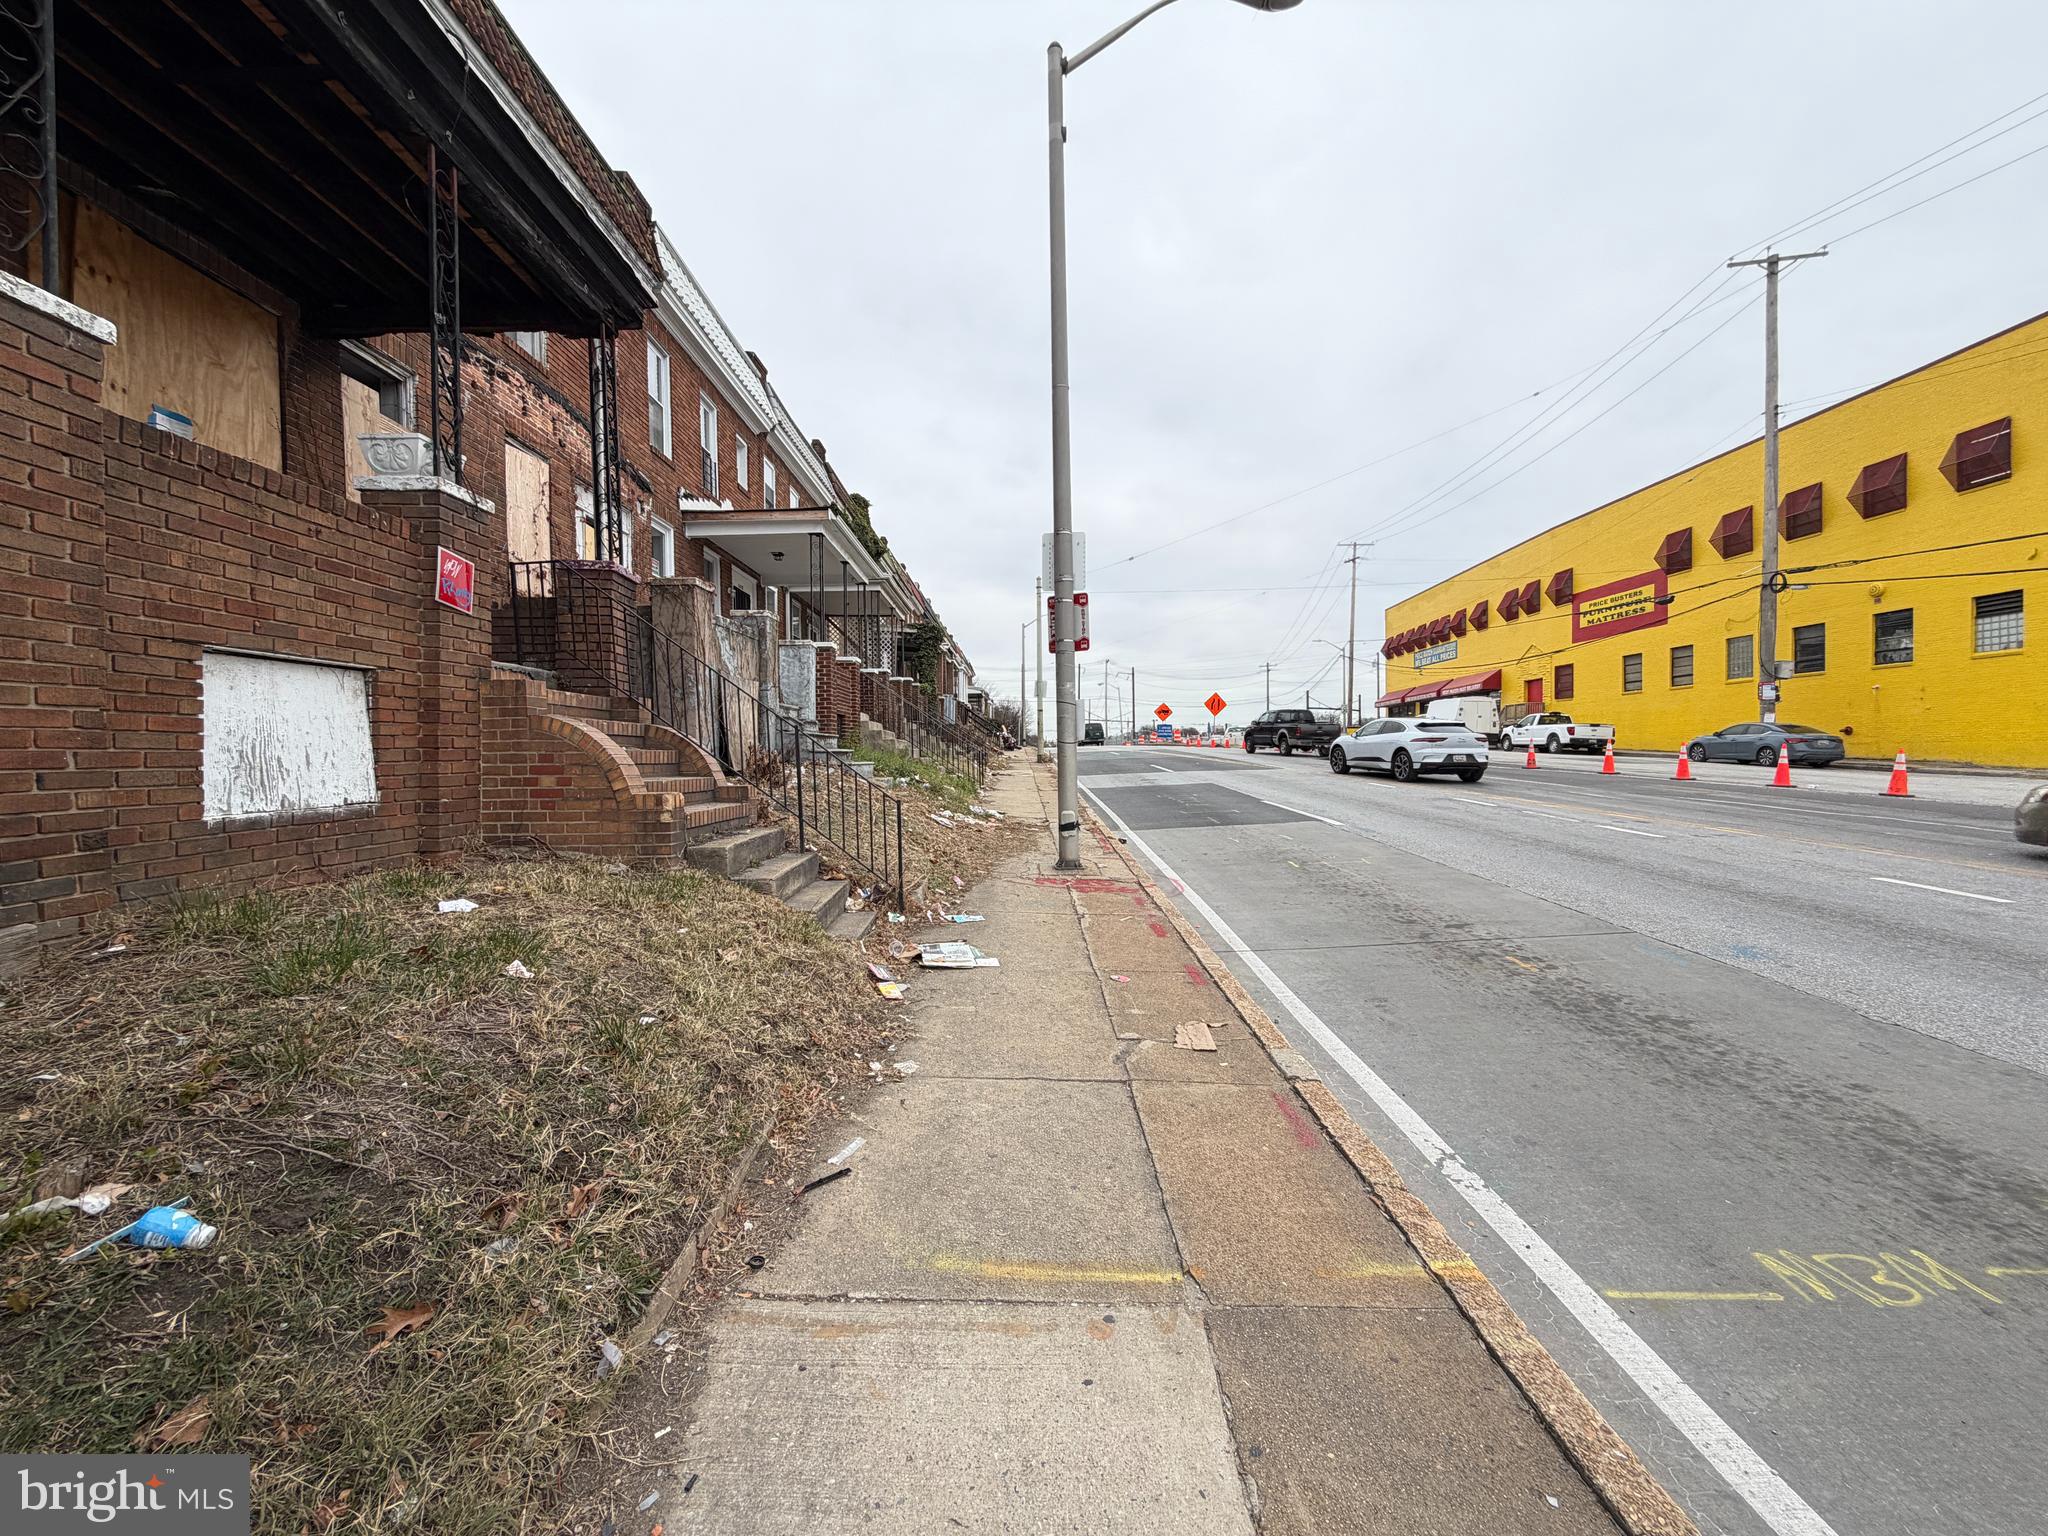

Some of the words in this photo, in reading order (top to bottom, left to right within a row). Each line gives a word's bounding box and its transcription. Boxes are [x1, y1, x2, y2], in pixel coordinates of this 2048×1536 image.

[1588, 599, 1608, 609] PRICE
[1610, 590, 1643, 603] BUSTERS
[1586, 606, 1646, 625] MATTRESS
